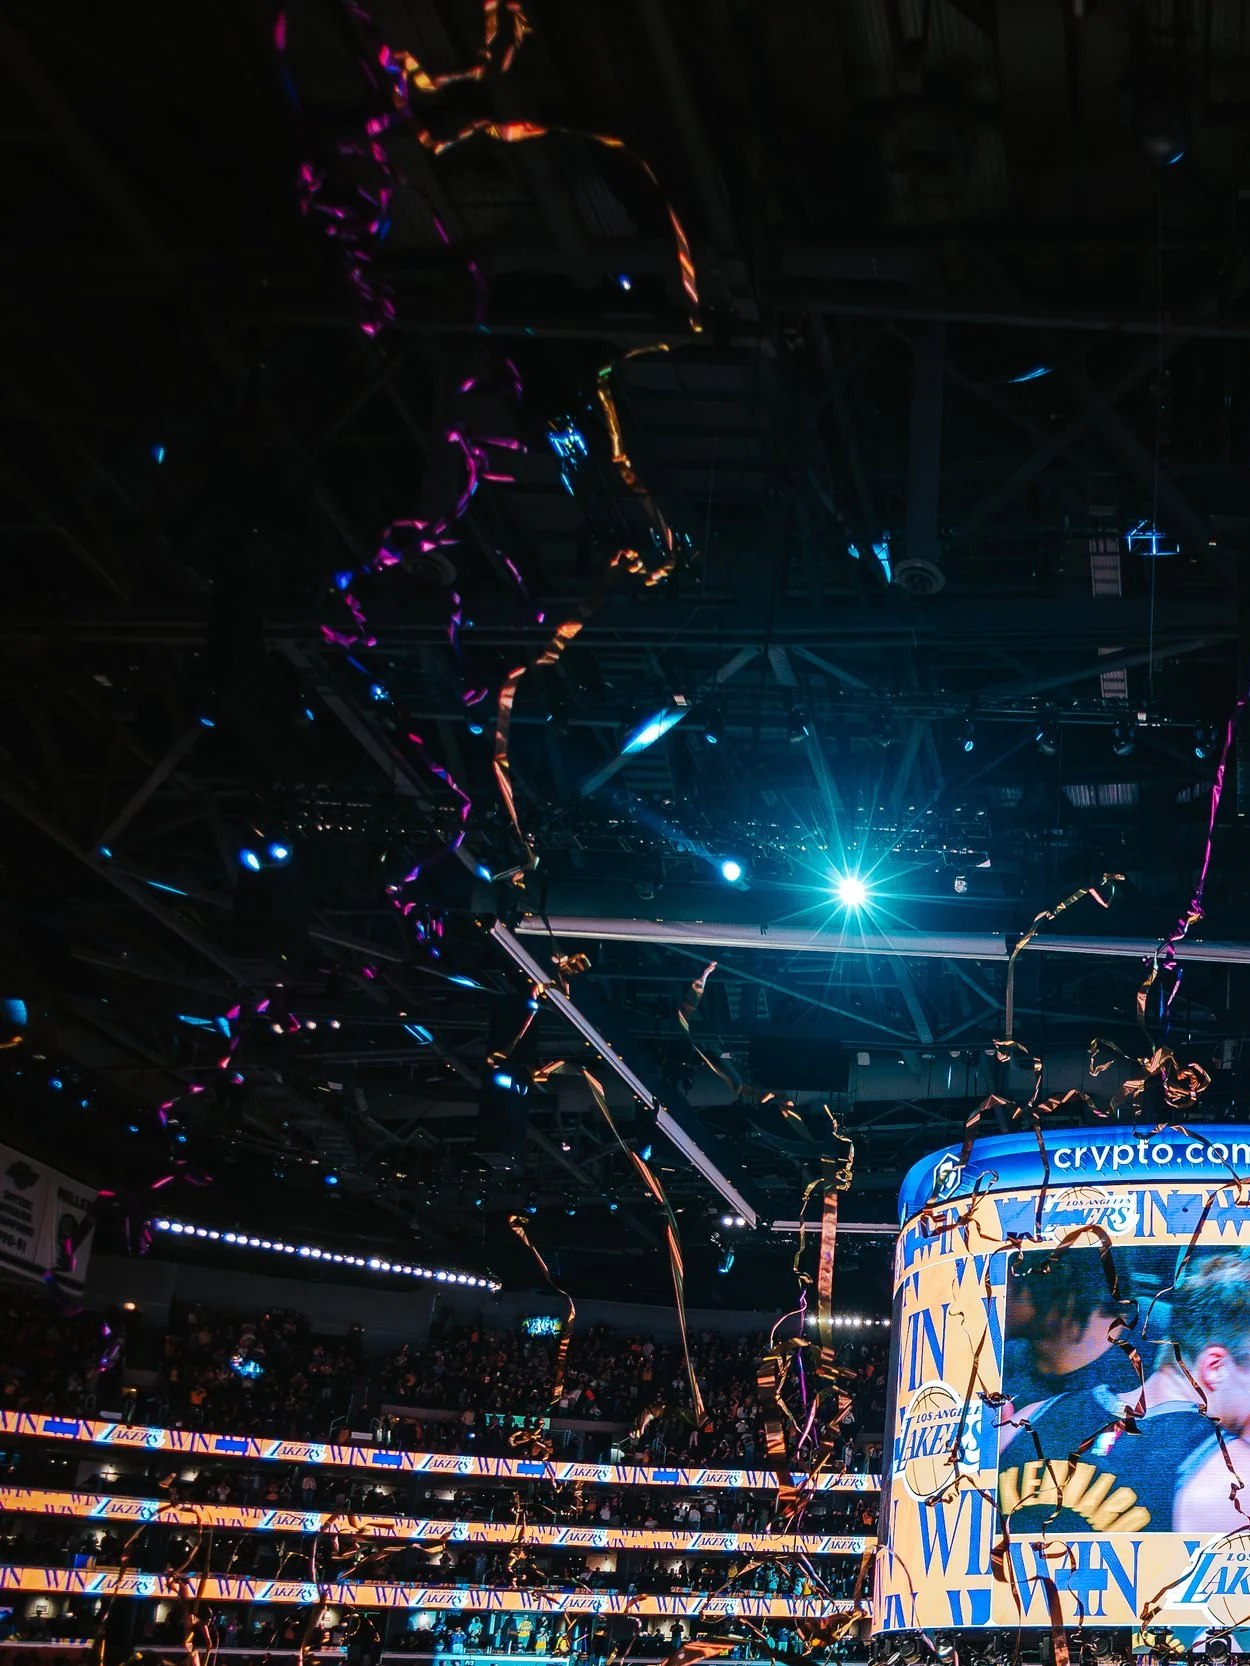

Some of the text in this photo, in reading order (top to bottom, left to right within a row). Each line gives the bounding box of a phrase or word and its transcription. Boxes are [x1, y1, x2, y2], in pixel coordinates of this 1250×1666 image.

[916, 1411, 933, 1424] LOS
[101, 1424, 160, 1446] LAKERS
[270, 1440, 321, 1461] LAKERS
[422, 1454, 471, 1474] LAKERS
[562, 1463, 609, 1482] LAKERS
[697, 1470, 740, 1487] LAKERS
[94, 1498, 153, 1520] LAKERS
[264, 1511, 315, 1531] LAKERS
[558, 1529, 605, 1546] LAKERS
[691, 1534, 736, 1550] LAKERS
[820, 1537, 864, 1554] LAKERS
[260, 1583, 315, 1603] LAKERS
[417, 1590, 463, 1608] LAKERS
[1008, 1541, 1143, 1618] WIN
